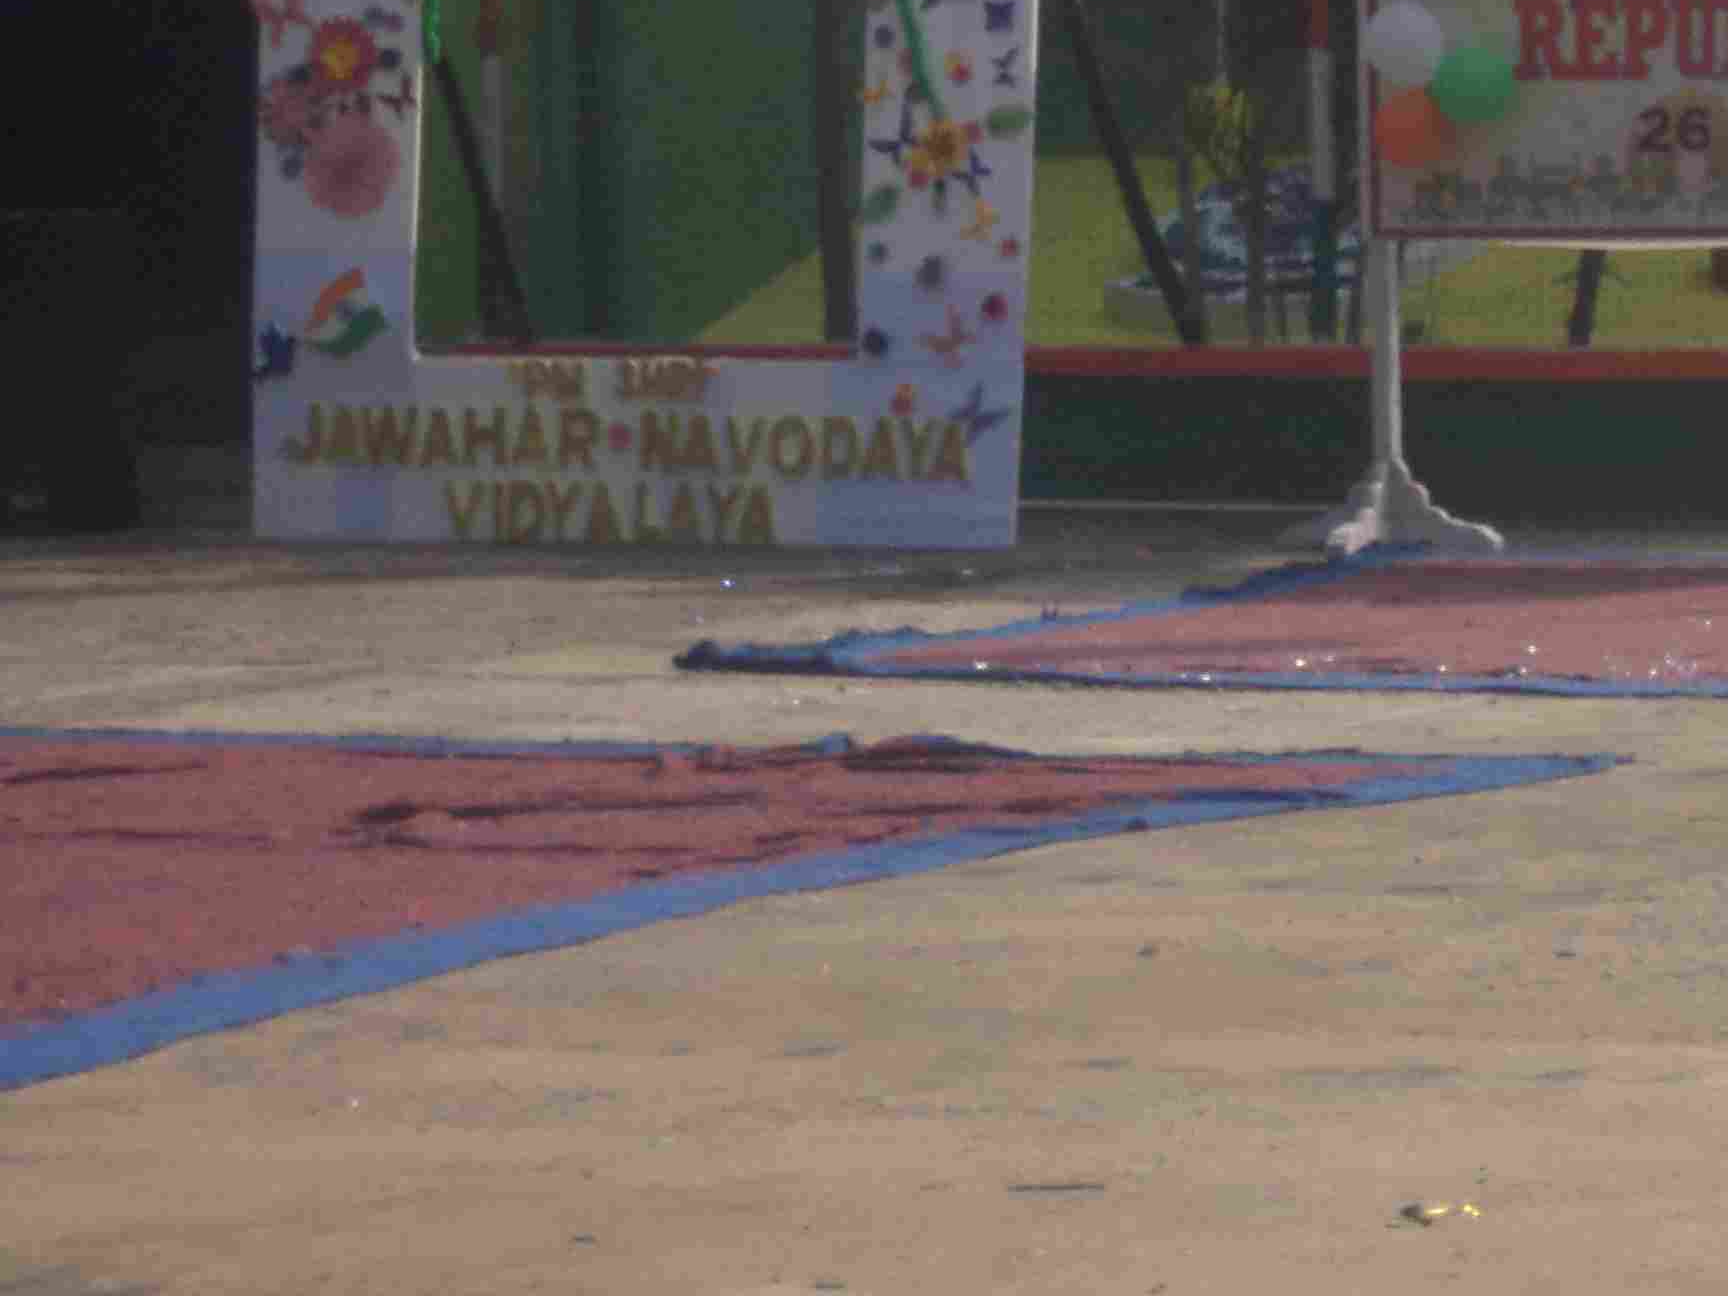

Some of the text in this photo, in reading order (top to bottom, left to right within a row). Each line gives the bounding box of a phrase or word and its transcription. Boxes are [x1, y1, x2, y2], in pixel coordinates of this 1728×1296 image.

[1637, 108, 1711, 153] 26
[290, 404, 970, 482] JAWAHAR NAVODAYA
[445, 481, 776, 544] VIDYALAYA
